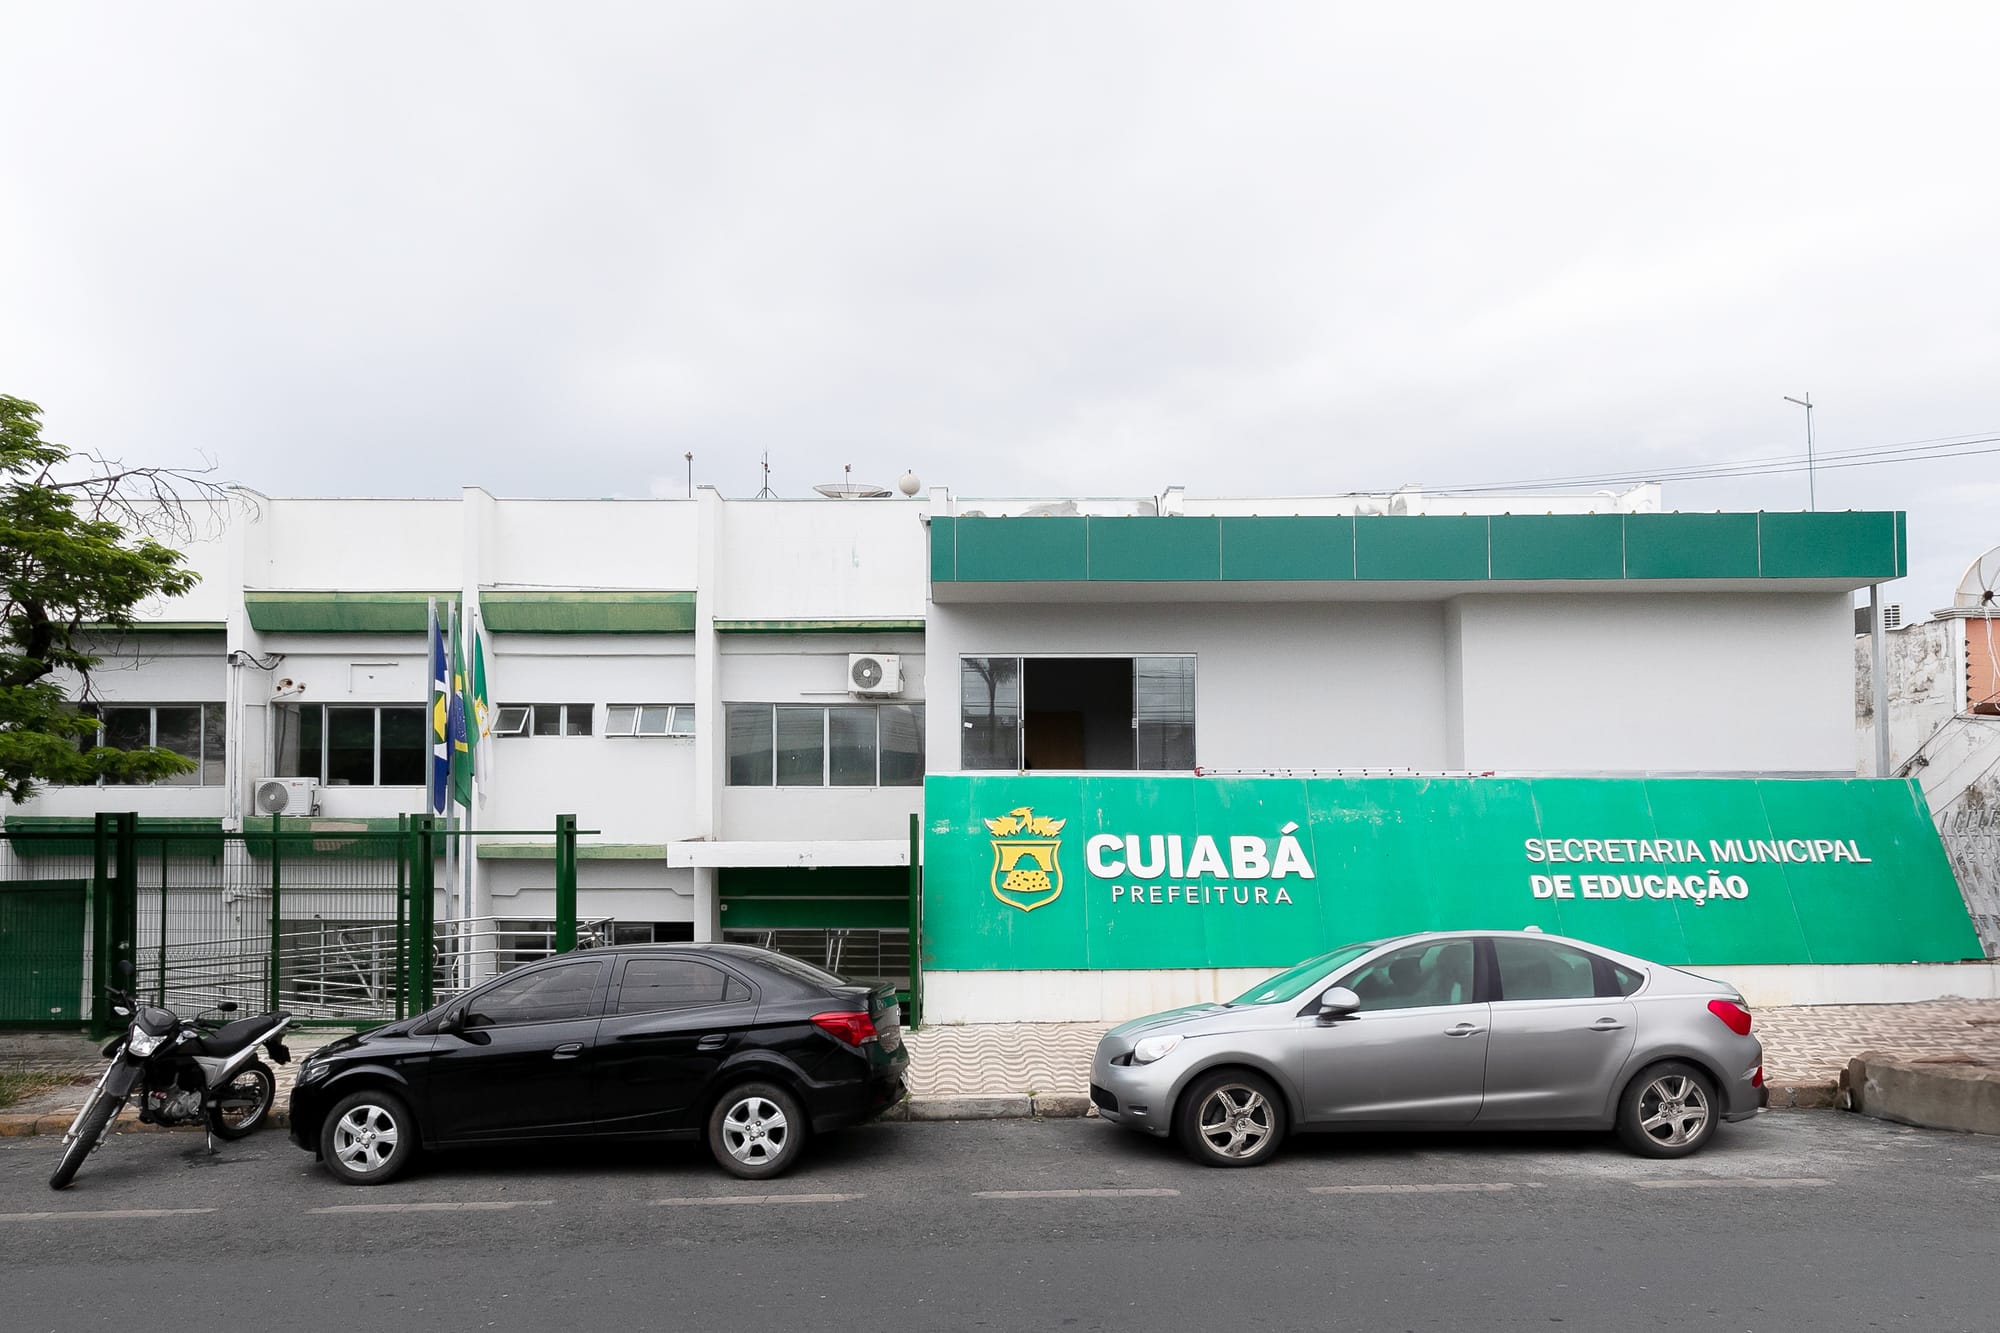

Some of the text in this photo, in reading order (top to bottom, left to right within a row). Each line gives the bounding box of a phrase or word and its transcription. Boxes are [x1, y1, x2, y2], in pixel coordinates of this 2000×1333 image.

[1086, 821, 1316, 879] CUIABÁ
[1524, 838, 1872, 863] SECRETARIA MUNICIPAL
[1111, 885, 1293, 904] PREFEITURA
[1530, 869, 1749, 906] DE EDUCAÇÃO
